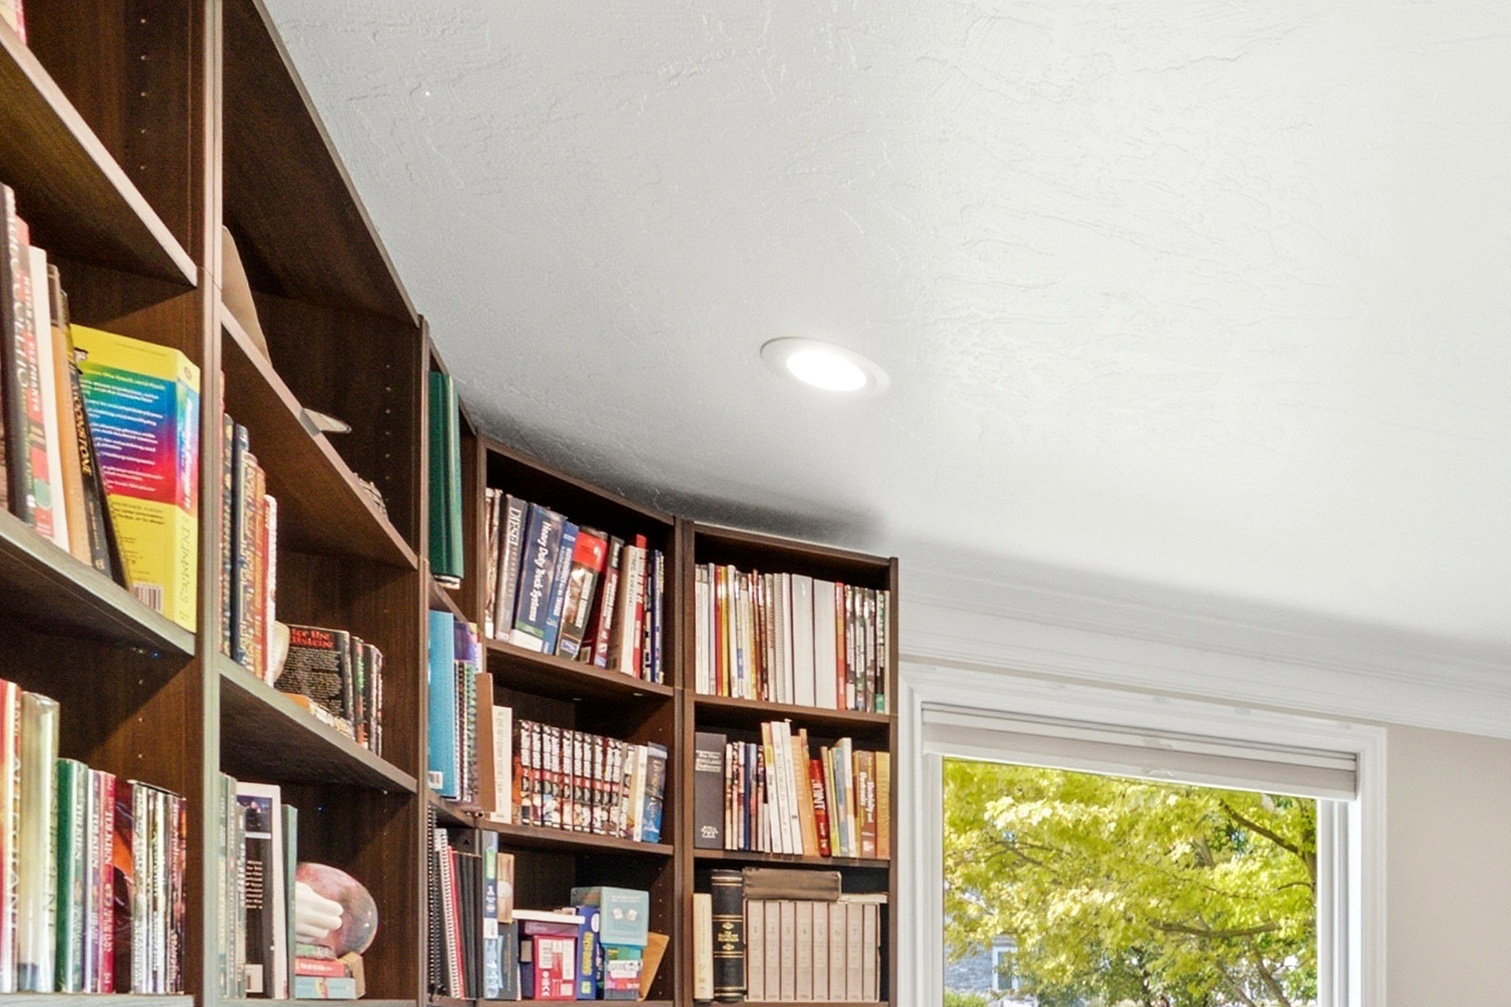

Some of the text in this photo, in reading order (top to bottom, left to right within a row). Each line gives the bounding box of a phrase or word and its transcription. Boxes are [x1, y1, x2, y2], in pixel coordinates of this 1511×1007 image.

[27, 341, 40, 413] ELEPHANTS
[506, 507, 522, 547] DIESEL
[529, 521, 551, 622] Heavy Duty Truck Systems
[92, 814, 100, 869] TOLKIEN
[104, 812, 114, 866] TOLKIEN
